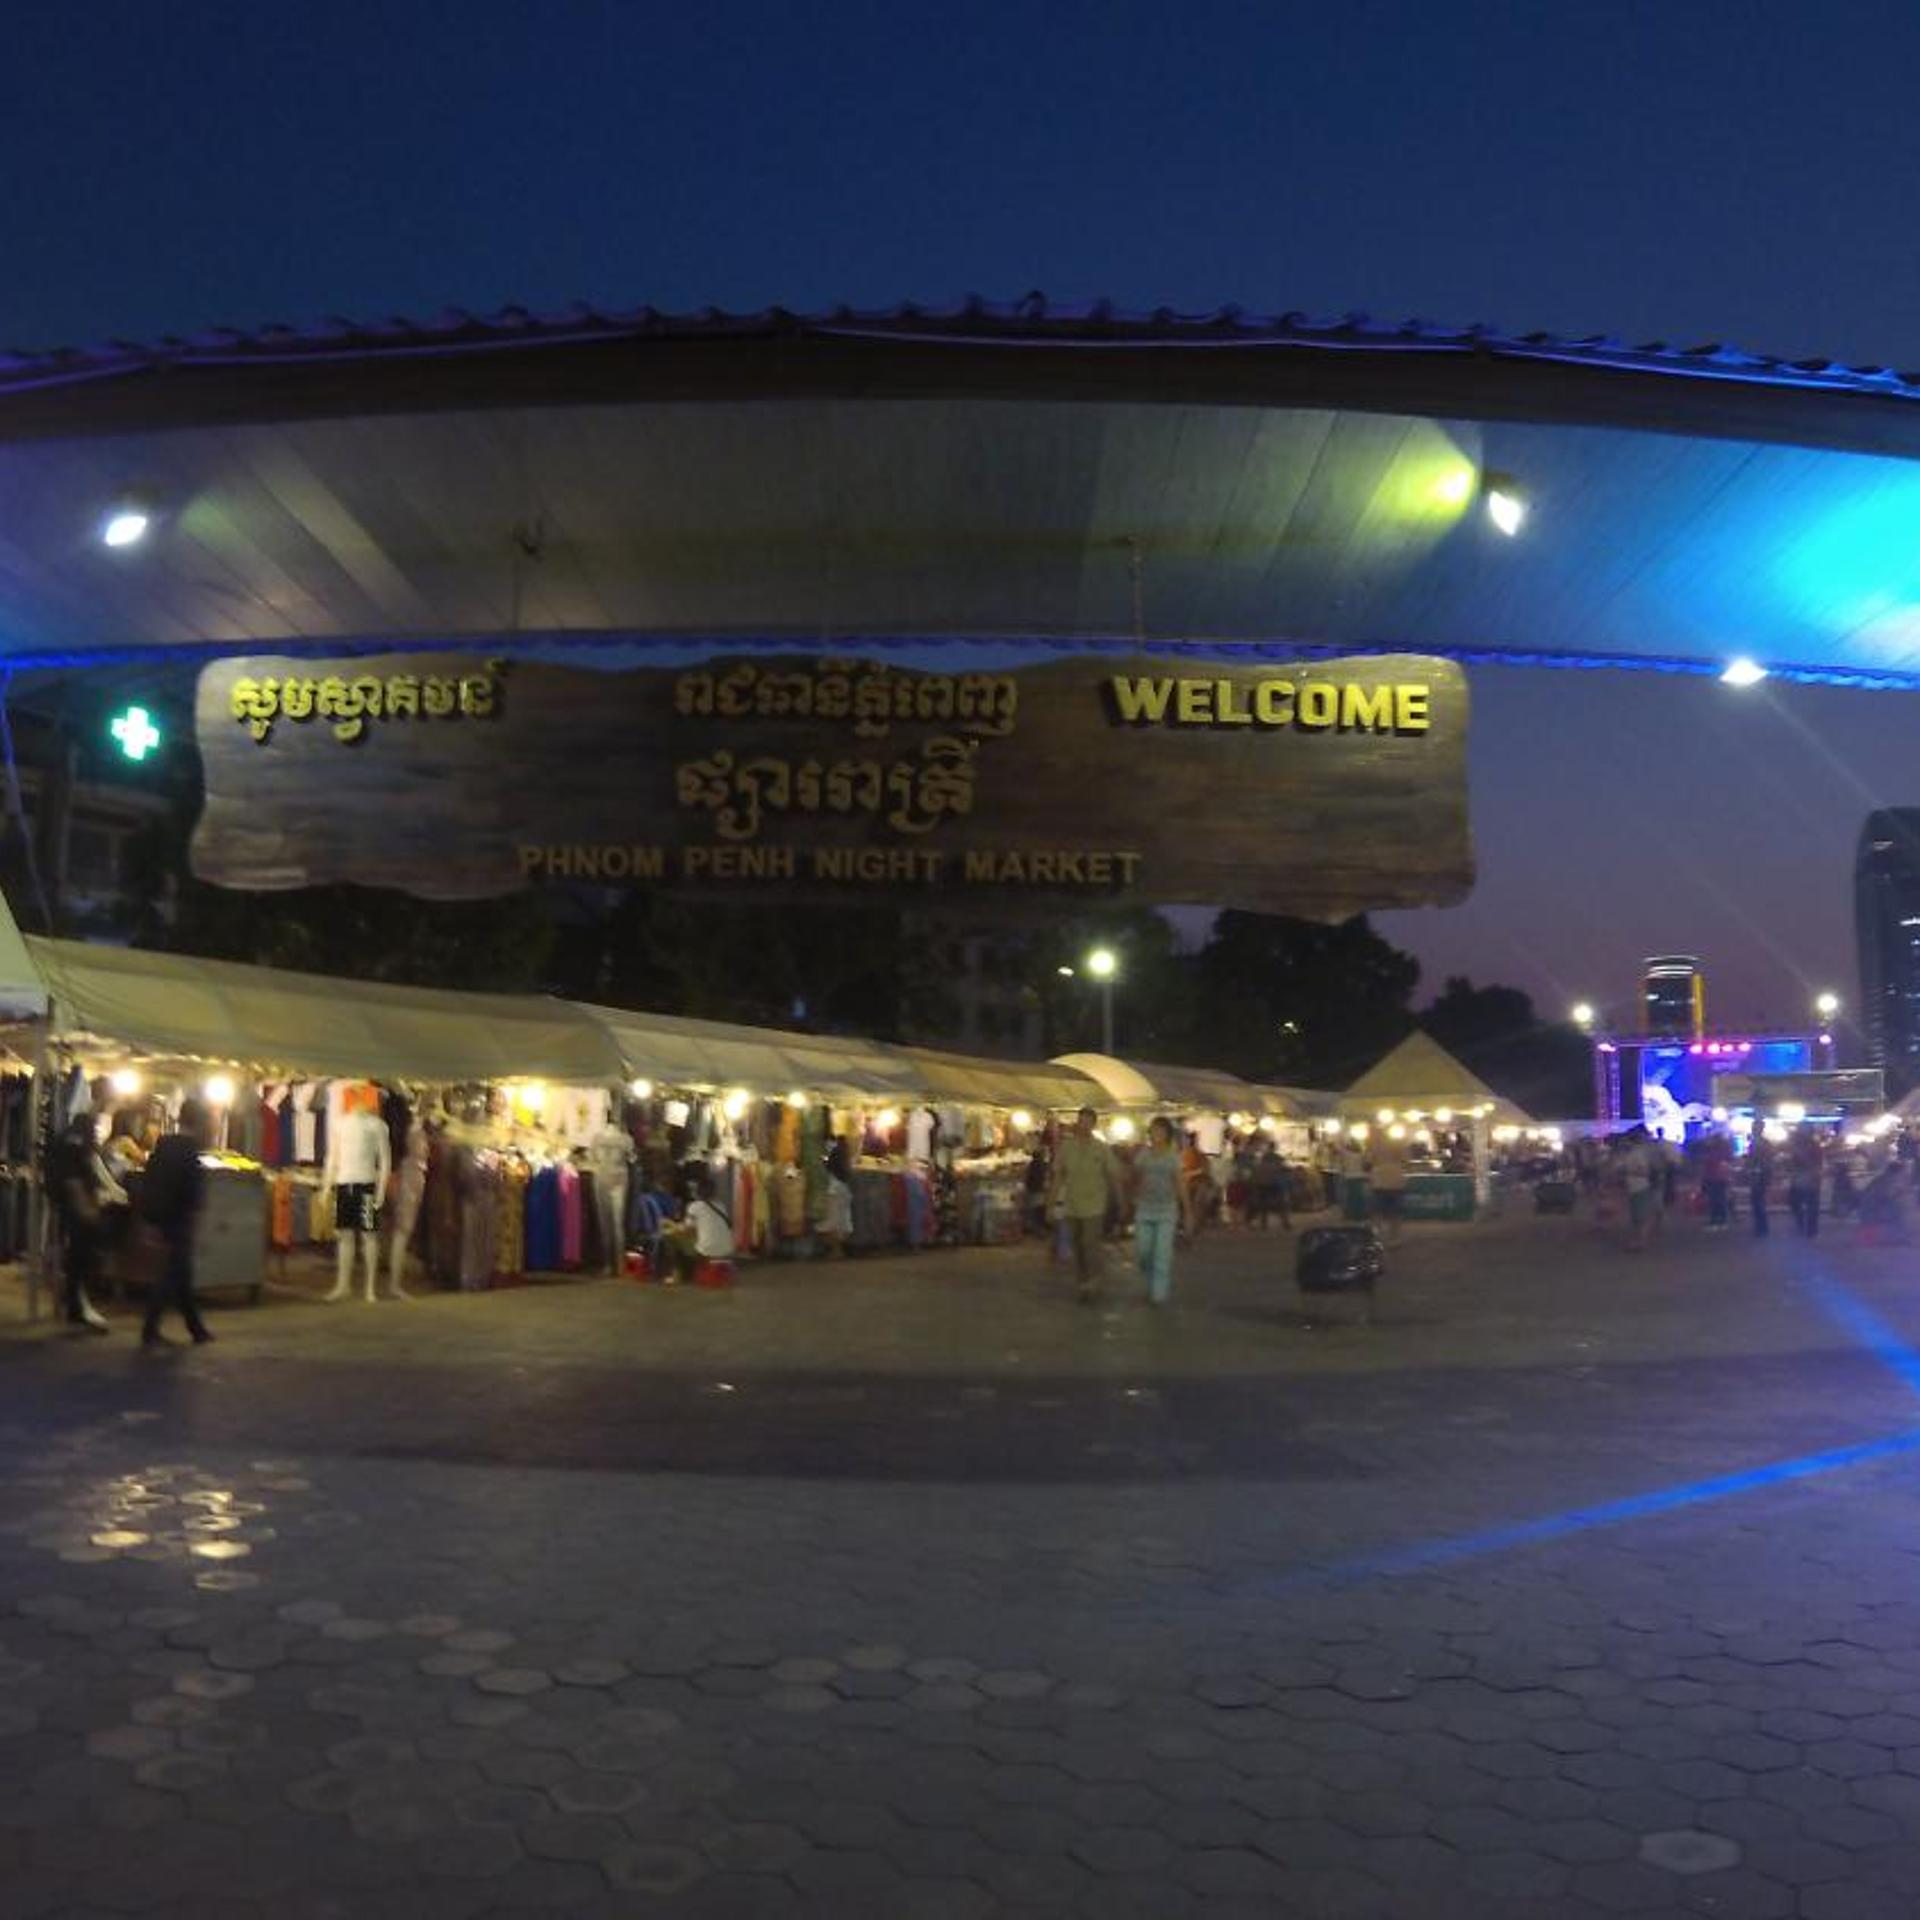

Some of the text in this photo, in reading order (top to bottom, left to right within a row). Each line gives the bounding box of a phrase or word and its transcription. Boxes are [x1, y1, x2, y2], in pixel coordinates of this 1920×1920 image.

[230, 657, 506, 742] សូមស្វាគមន៍
[1112, 675, 1431, 732] WELCOME
[675, 735, 978, 839] ផ្សាររាត្រី
[517, 843, 1143, 885] PHNOM PENH NIGHT MARKET
